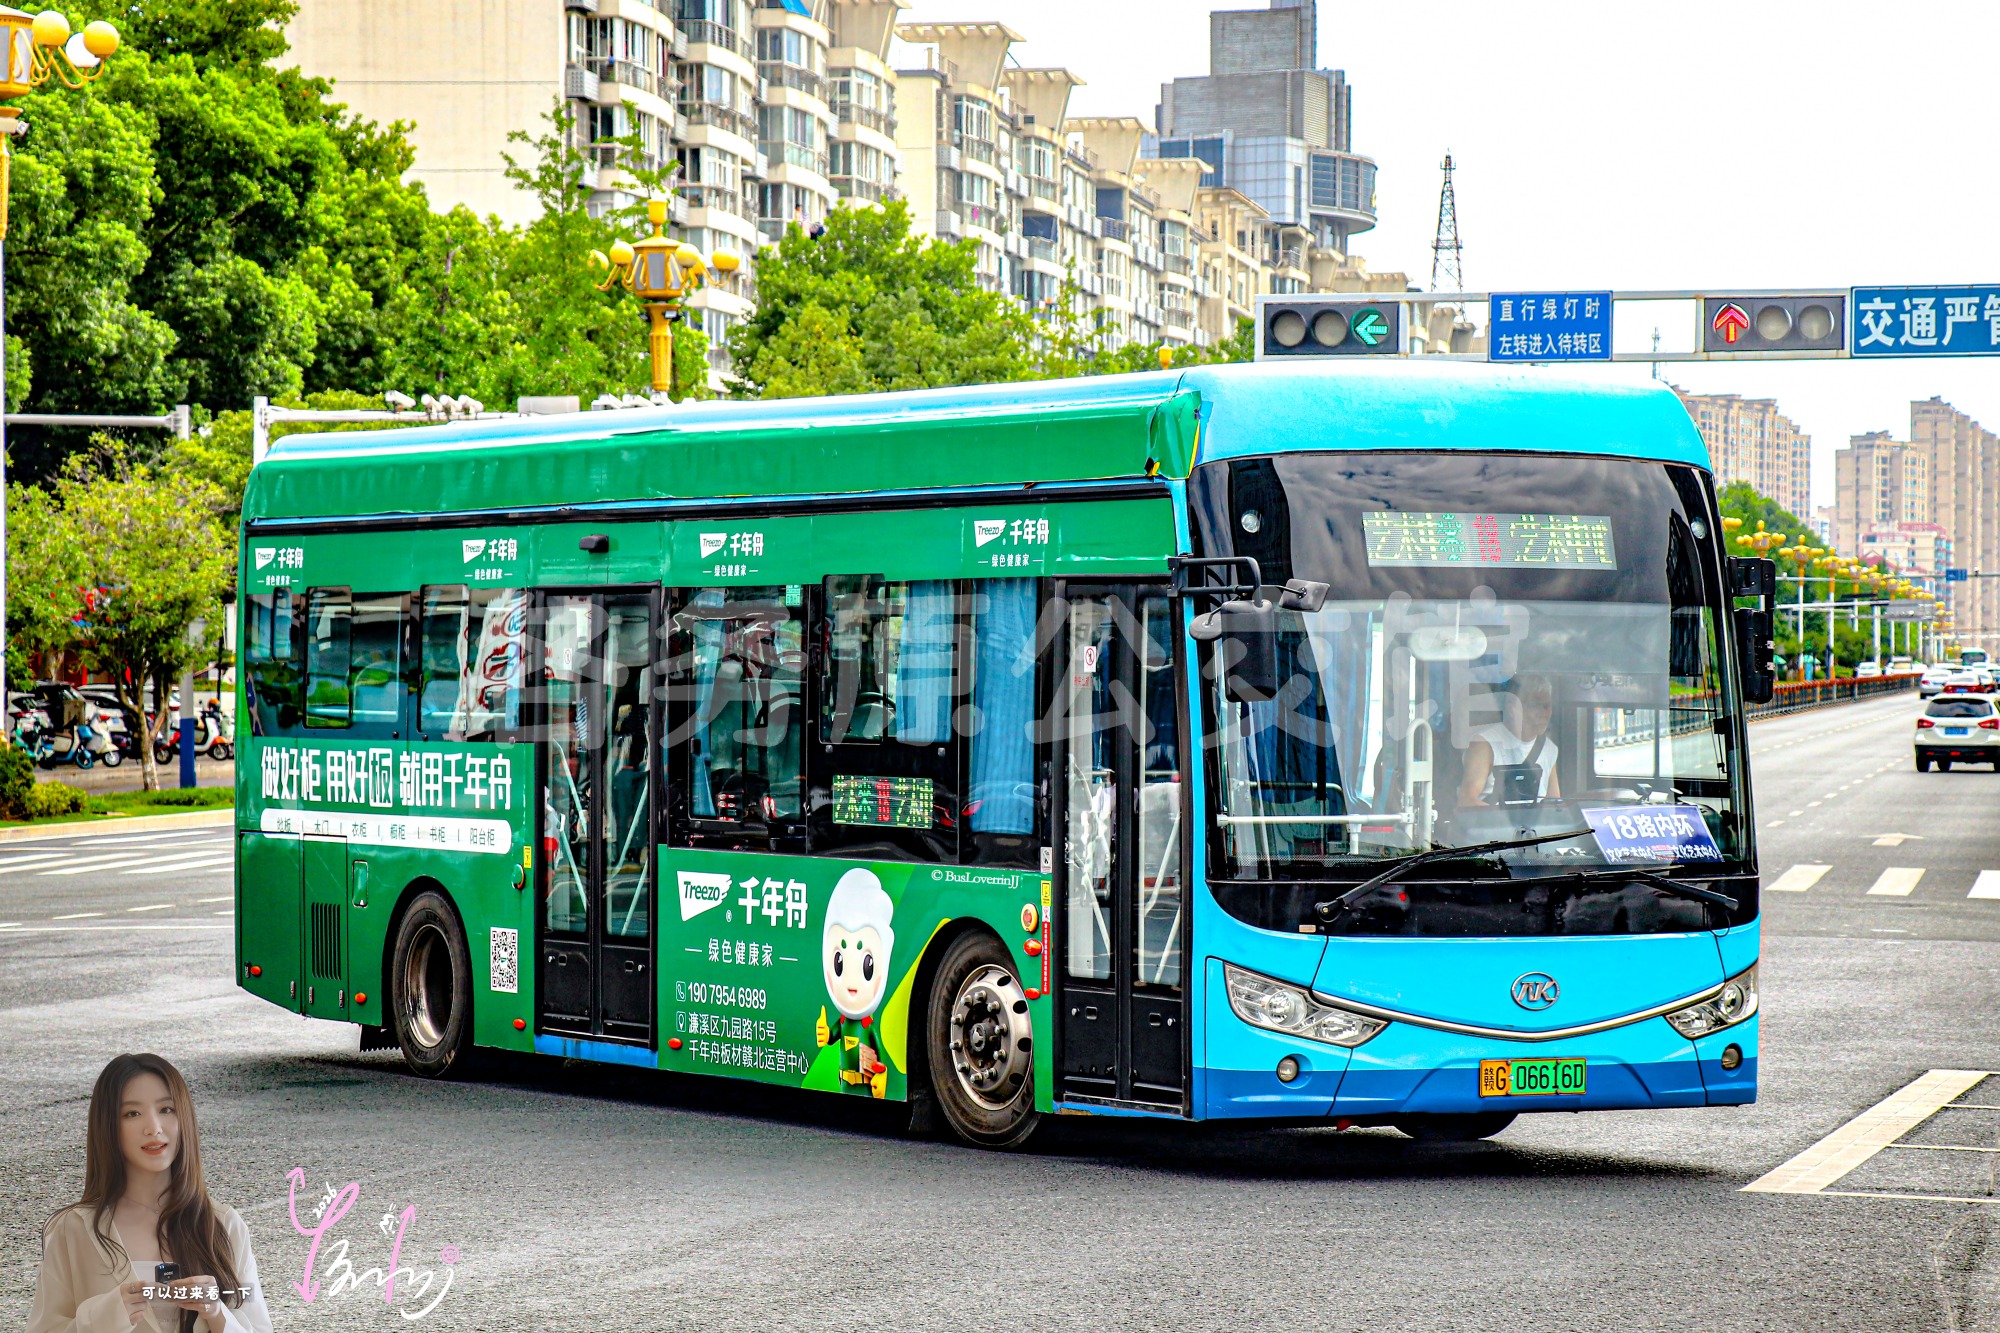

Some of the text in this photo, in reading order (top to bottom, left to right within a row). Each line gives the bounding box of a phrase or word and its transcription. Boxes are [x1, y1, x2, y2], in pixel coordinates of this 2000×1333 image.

[1500, 298, 1600, 321] 直行绿灯时
[1499, 332, 1602, 355] 左转进入待转区
[730, 532, 763, 556] 千年舟
[1010, 518, 1049, 545] 千年舟
[278, 547, 303, 568] 千年舟
[488, 538, 517, 561] 千年舟
[992, 553, 1029, 567] 绿色健康家
[261, 746, 321, 801] 做好柜
[400, 751, 512, 810] 就用千年舟
[314, 819, 328, 835] 木门
[352, 822, 367, 837] 衣柜
[430, 826, 445, 843] 书柜
[470, 827, 495, 846] 阳台柜
[1602, 813, 1694, 840] 18路内环
[684, 876, 808, 928] Treezo 千年舟
[709, 938, 773, 967] 绿色健康家
[688, 982, 767, 1009] 190 7954 6989
[689, 1012, 777, 1043] 濂溪区九园路15号
[689, 1039, 810, 1074] 千年舟板材赣北运营中心
